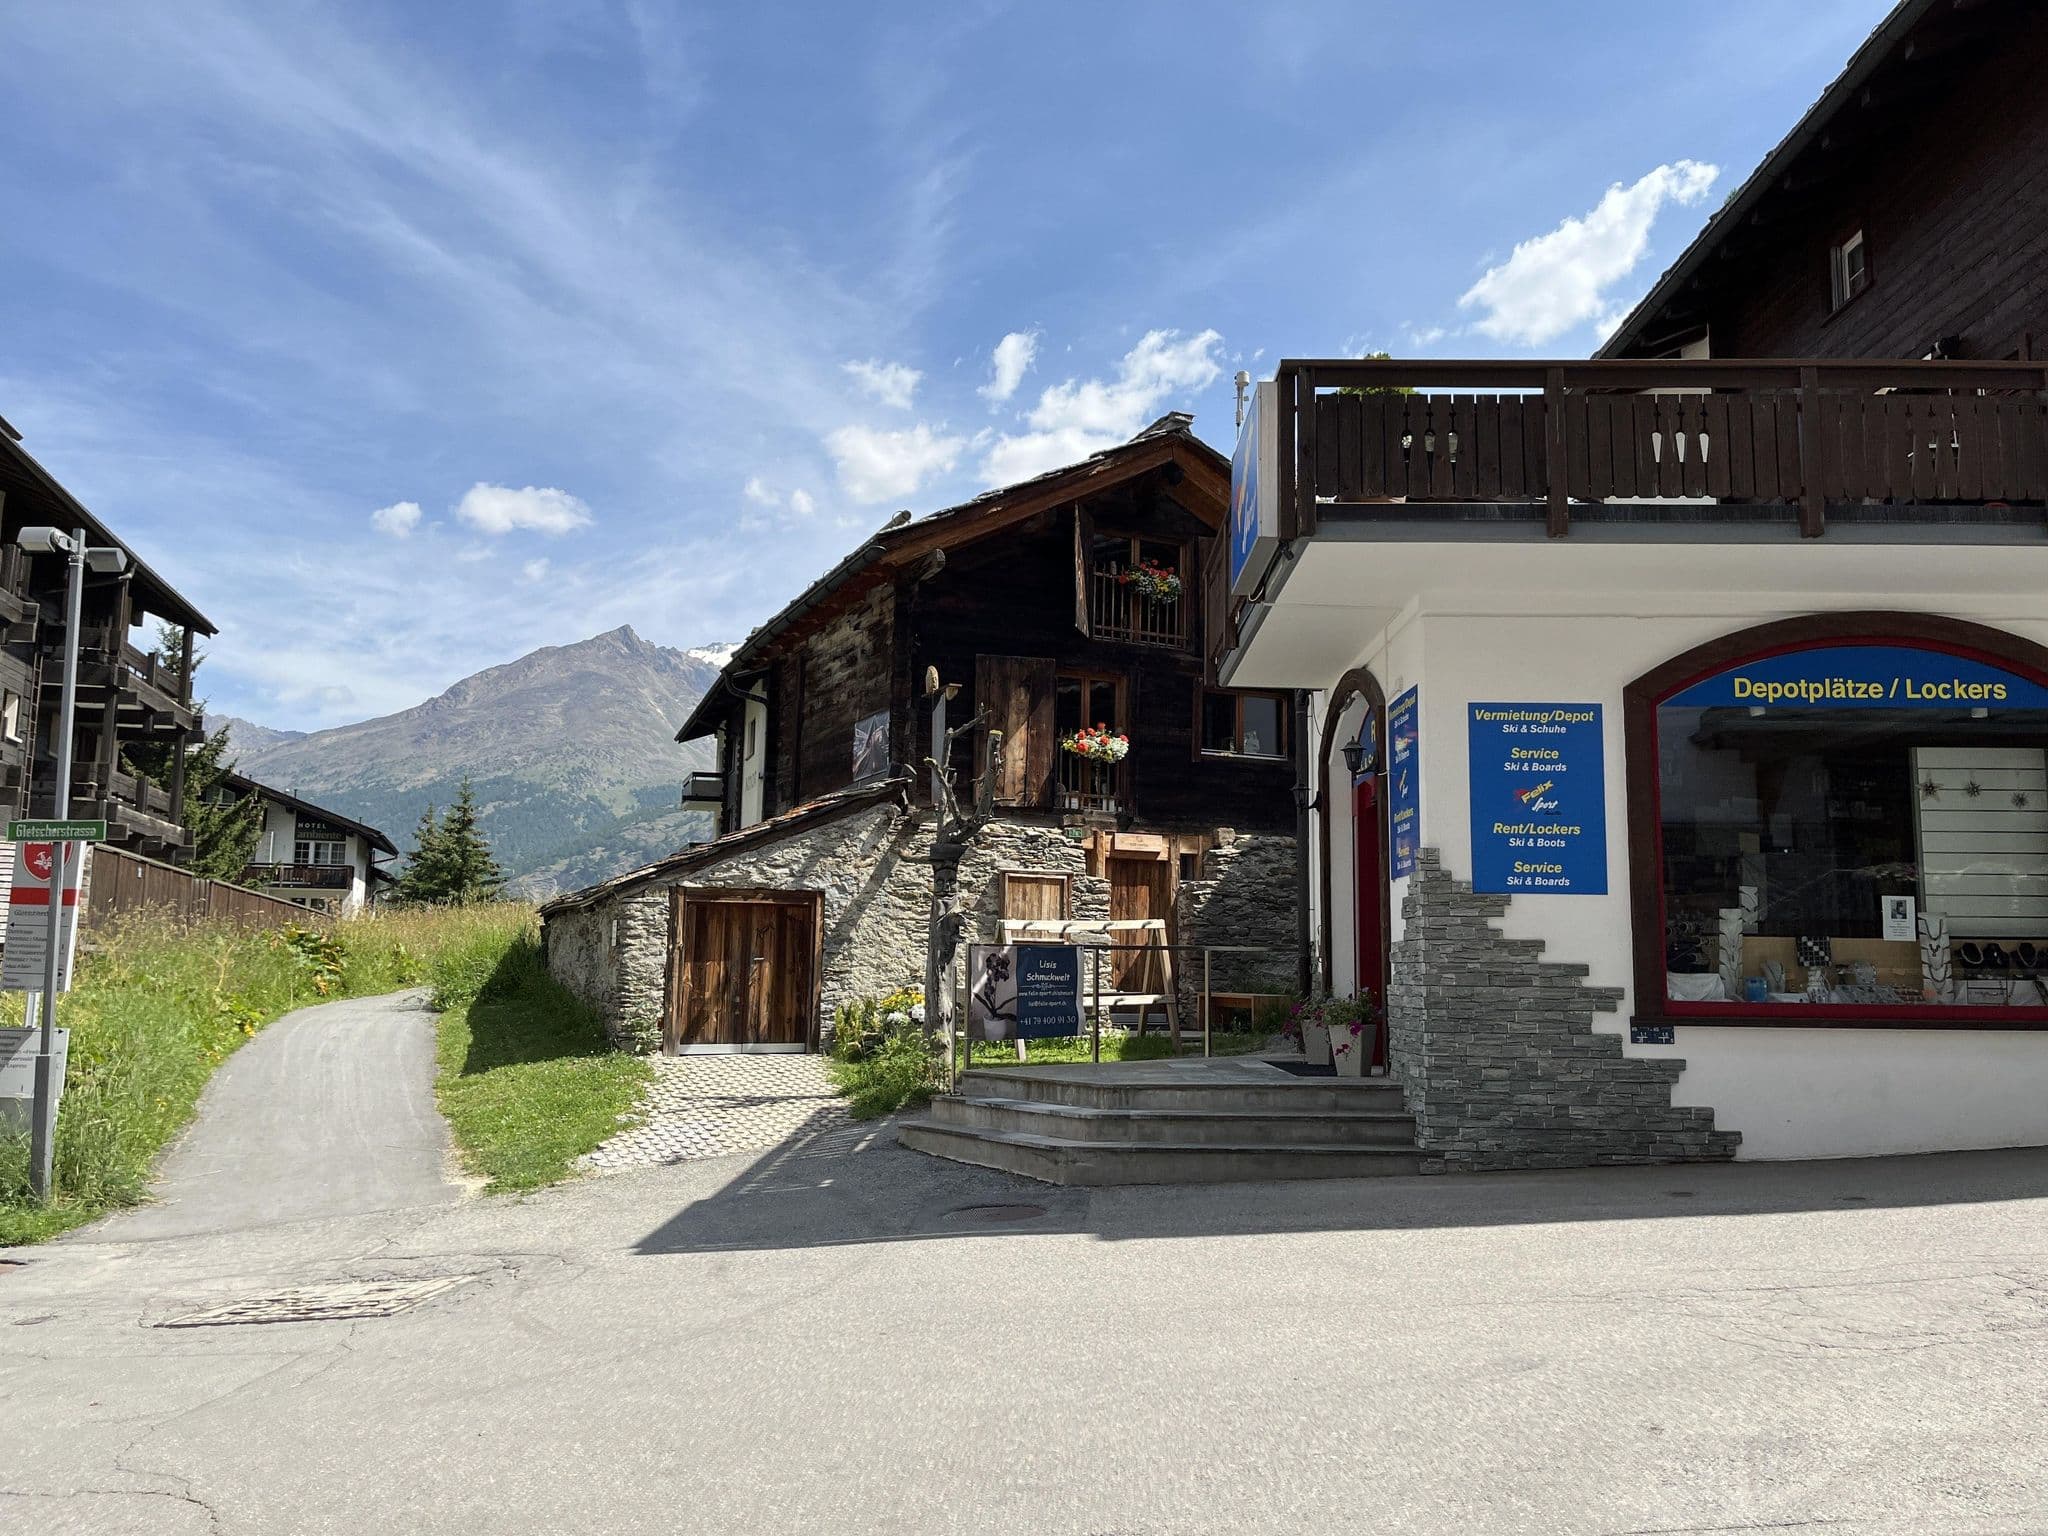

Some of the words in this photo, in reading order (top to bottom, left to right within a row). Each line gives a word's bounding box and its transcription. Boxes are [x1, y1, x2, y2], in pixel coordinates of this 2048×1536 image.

[1734, 677, 1884, 703] Depotplätze
[1889, 678, 1899, 699] /
[1906, 679, 2007, 700] Lockers
[1475, 709, 1594, 723] Vermietung/Depot
[1502, 724, 1518, 733] Ski
[1520, 725, 1527, 733] &
[1530, 724, 1567, 734] Schuhe
[1511, 747, 1559, 759] Service
[1504, 762, 1519, 771] Ski
[1522, 762, 1529, 771] &
[1532, 762, 1567, 772] Boards
[1521, 779, 1554, 804] Felix
[1531, 797, 1558, 812] Sport
[16, 823, 96, 838] Gletscherstrasse
[1493, 822, 1581, 835] Rent/Lockers
[1509, 838, 1525, 847] Ski
[1527, 838, 1534, 847] &
[1537, 838, 1566, 847] Boots
[1513, 861, 1563, 873] Service
[1506, 876, 1522, 885] Ski
[1525, 877, 1532, 885] &
[1535, 877, 1570, 886] Boards
[1039, 959, 1057, 969] Lisis
[1026, 972, 1071, 981] Schmuckwelt
[1020, 1017, 1031, 1026] +41
